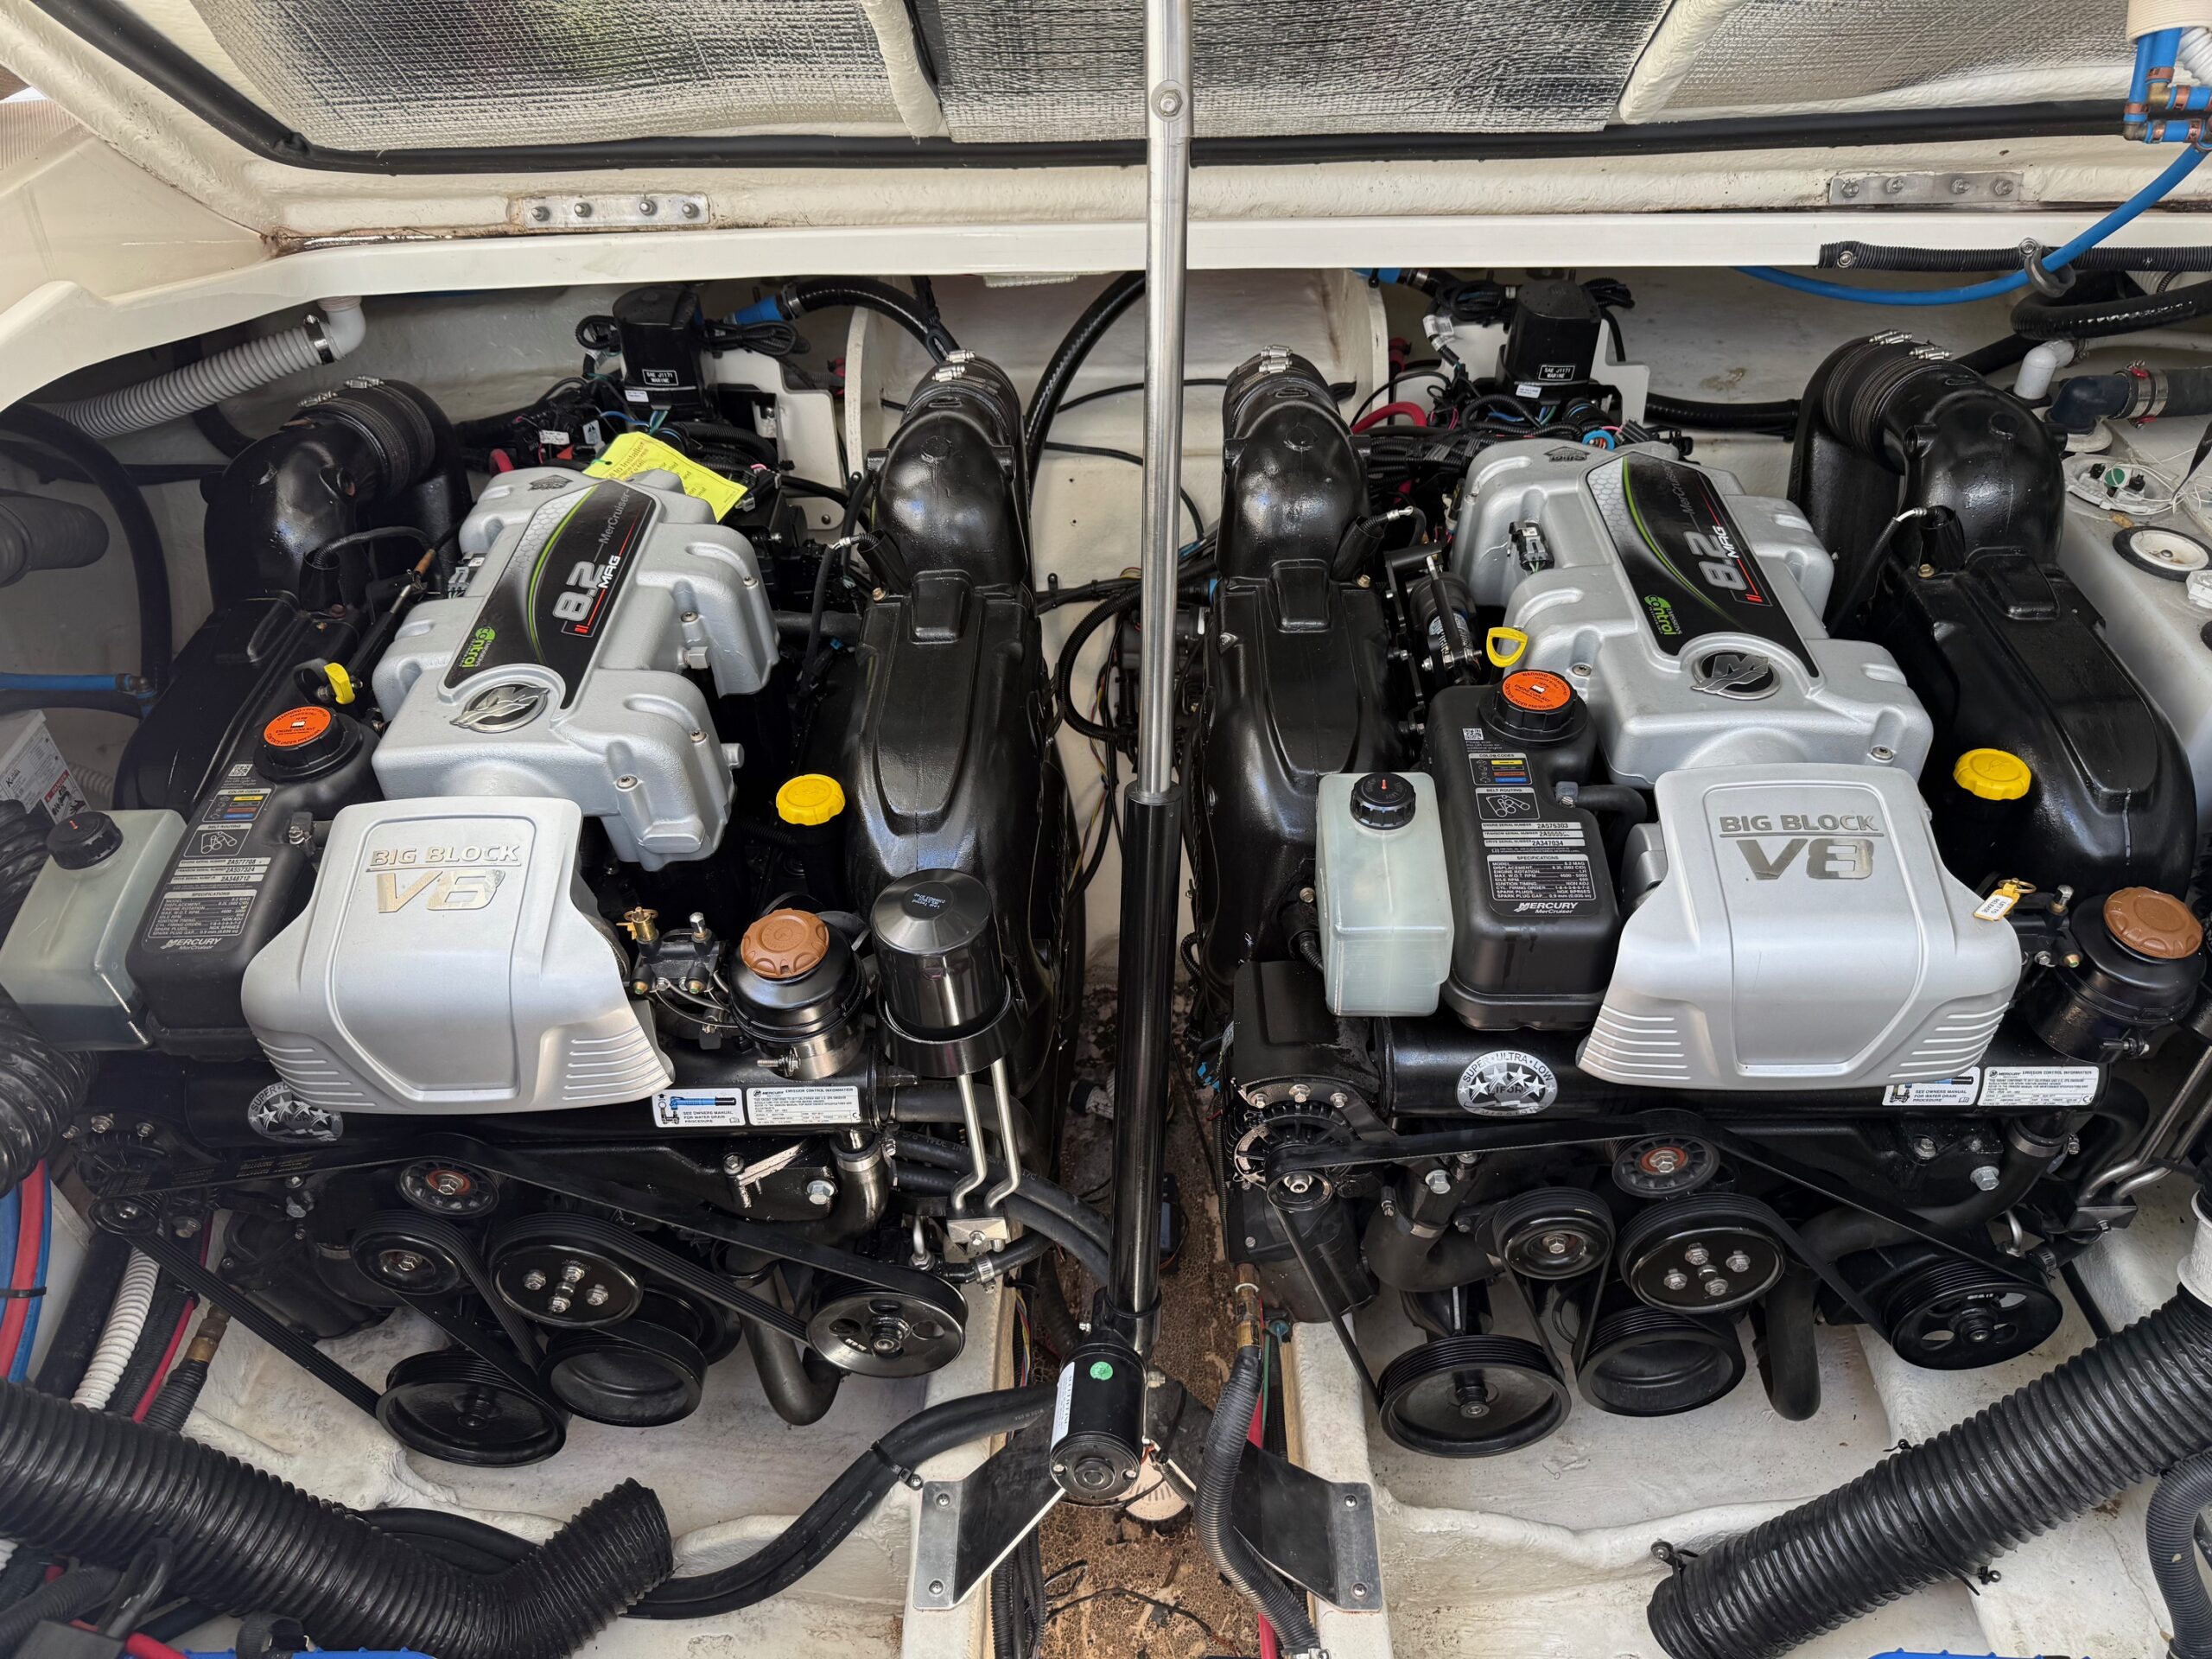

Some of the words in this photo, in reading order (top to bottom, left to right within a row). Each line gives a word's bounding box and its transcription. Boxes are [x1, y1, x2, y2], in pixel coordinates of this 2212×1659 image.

[598, 494, 629, 544] MerCruiser
[1712, 524, 1740, 559] MAG
[598, 555, 620, 588] MAG
[1684, 531, 1747, 591] 8.2
[552, 561, 607, 622] 8.2
[1719, 815, 1772, 832] BIG
[1780, 815, 1879, 830] BLOCK
[370, 849, 416, 866] BIG
[425, 845, 520, 862] BLOCK
[1736, 838, 1874, 880] V8
[377, 869, 506, 913] V8
[1518, 902, 1579, 911] MERCURY
[166, 938, 222, 947] MERCURY
[1463, 1058, 1490, 1083] SUPER
[1497, 1052, 1528, 1064] ULTRA
[1533, 1061, 1554, 1082] LOW
[251, 1085, 276, 1112] SUPER
[926, 1137, 947, 1147] MADE
[952, 1143, 963, 1153] IN
